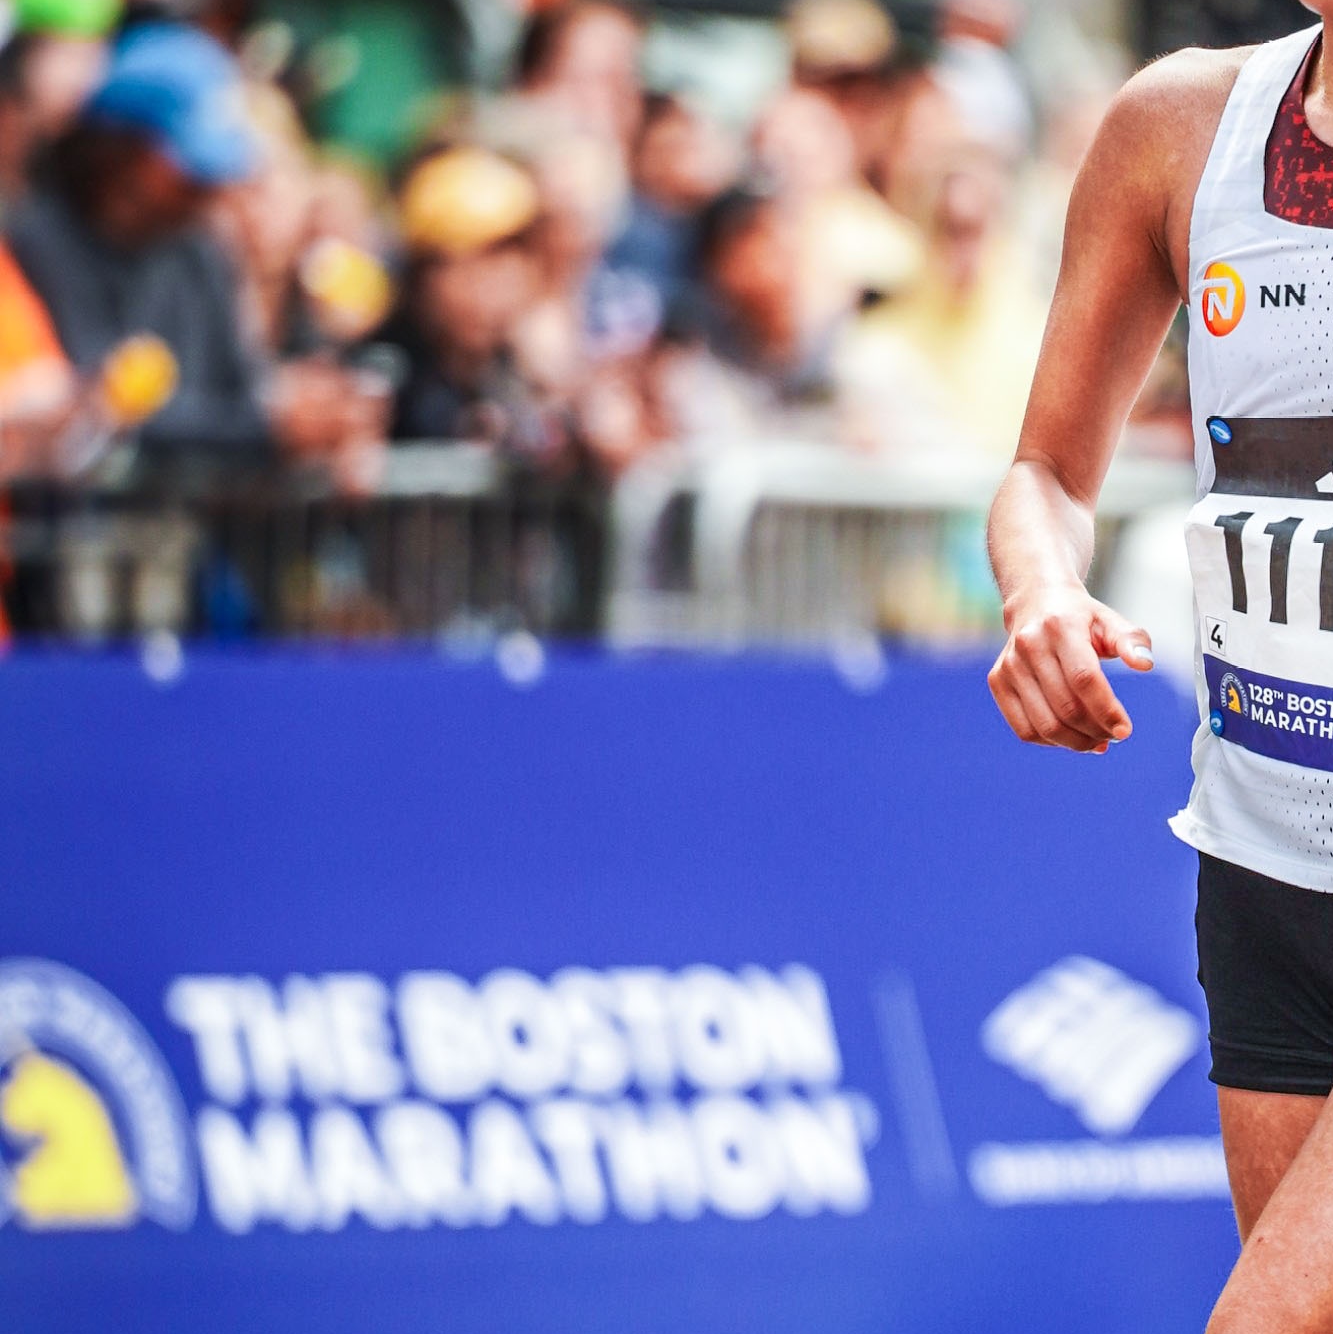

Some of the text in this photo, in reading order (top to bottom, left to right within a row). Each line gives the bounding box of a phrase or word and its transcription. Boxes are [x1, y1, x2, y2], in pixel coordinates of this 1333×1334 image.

[1259, 282, 1305, 309] NN
[1210, 623, 1224, 649] 4
[164, 969, 400, 1105] THE
[398, 962, 844, 1102] BOSTON
[197, 1089, 874, 1237] MARATHON
